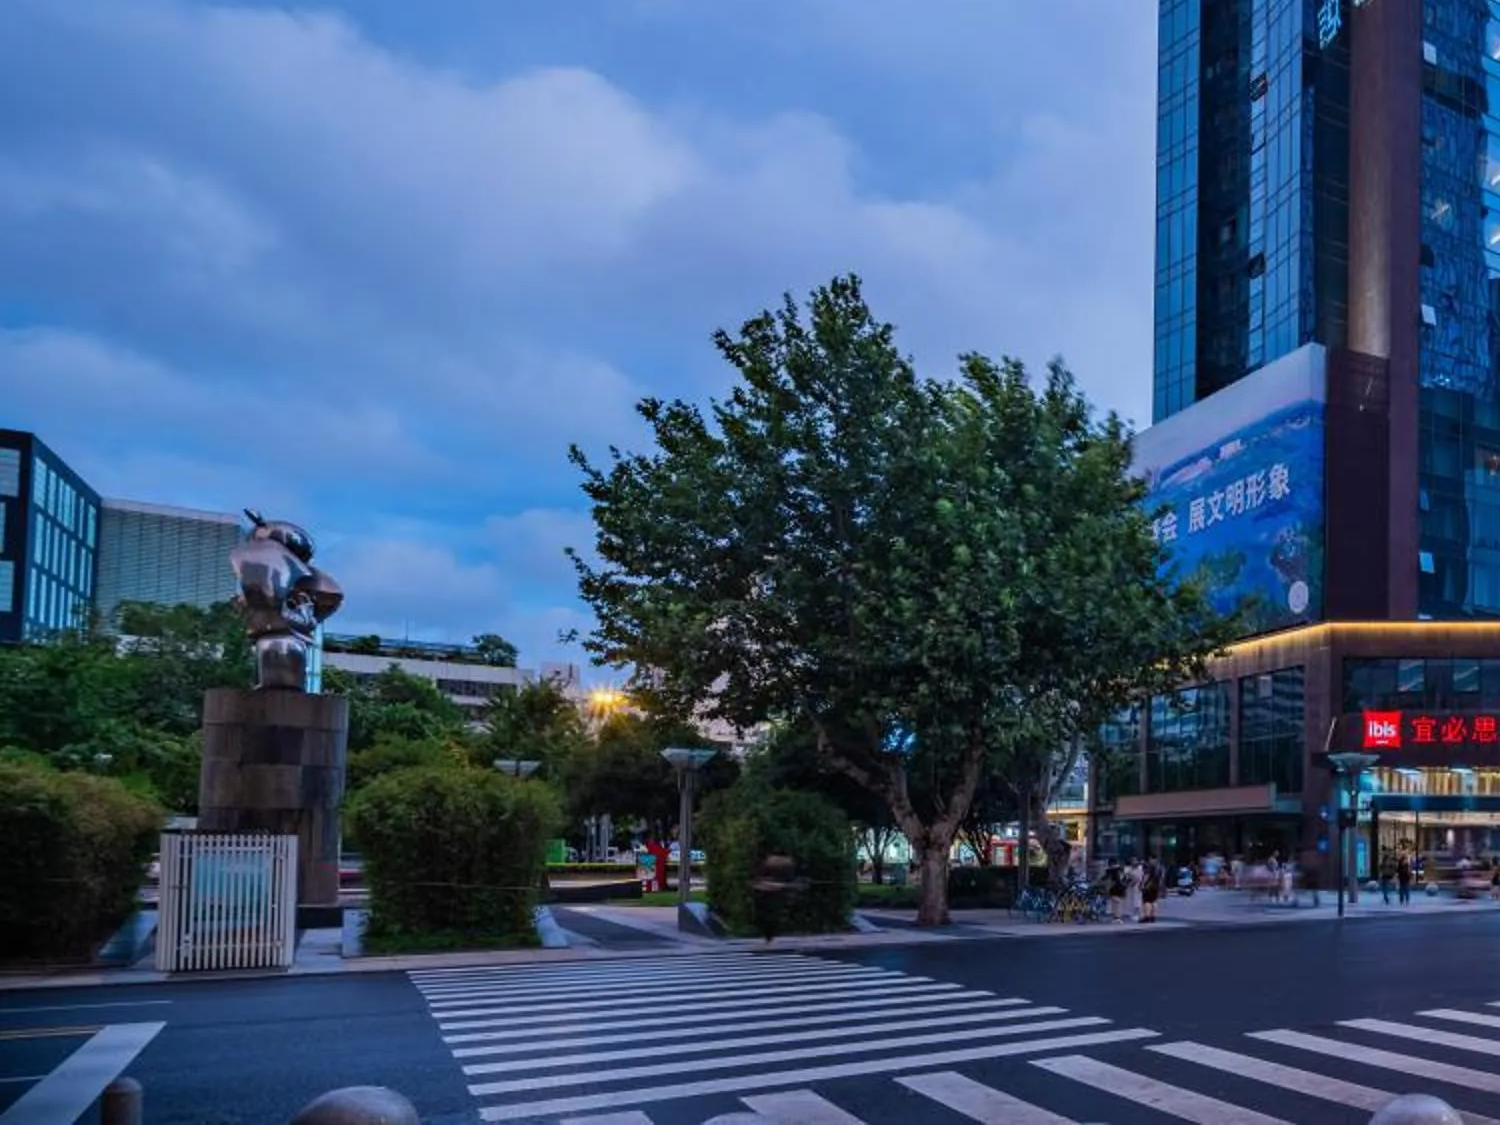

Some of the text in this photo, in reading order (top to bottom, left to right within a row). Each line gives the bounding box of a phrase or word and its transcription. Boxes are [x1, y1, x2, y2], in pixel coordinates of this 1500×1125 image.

[1188, 462, 1291, 534] 展文明形象
[1368, 720, 1397, 737] ibis
